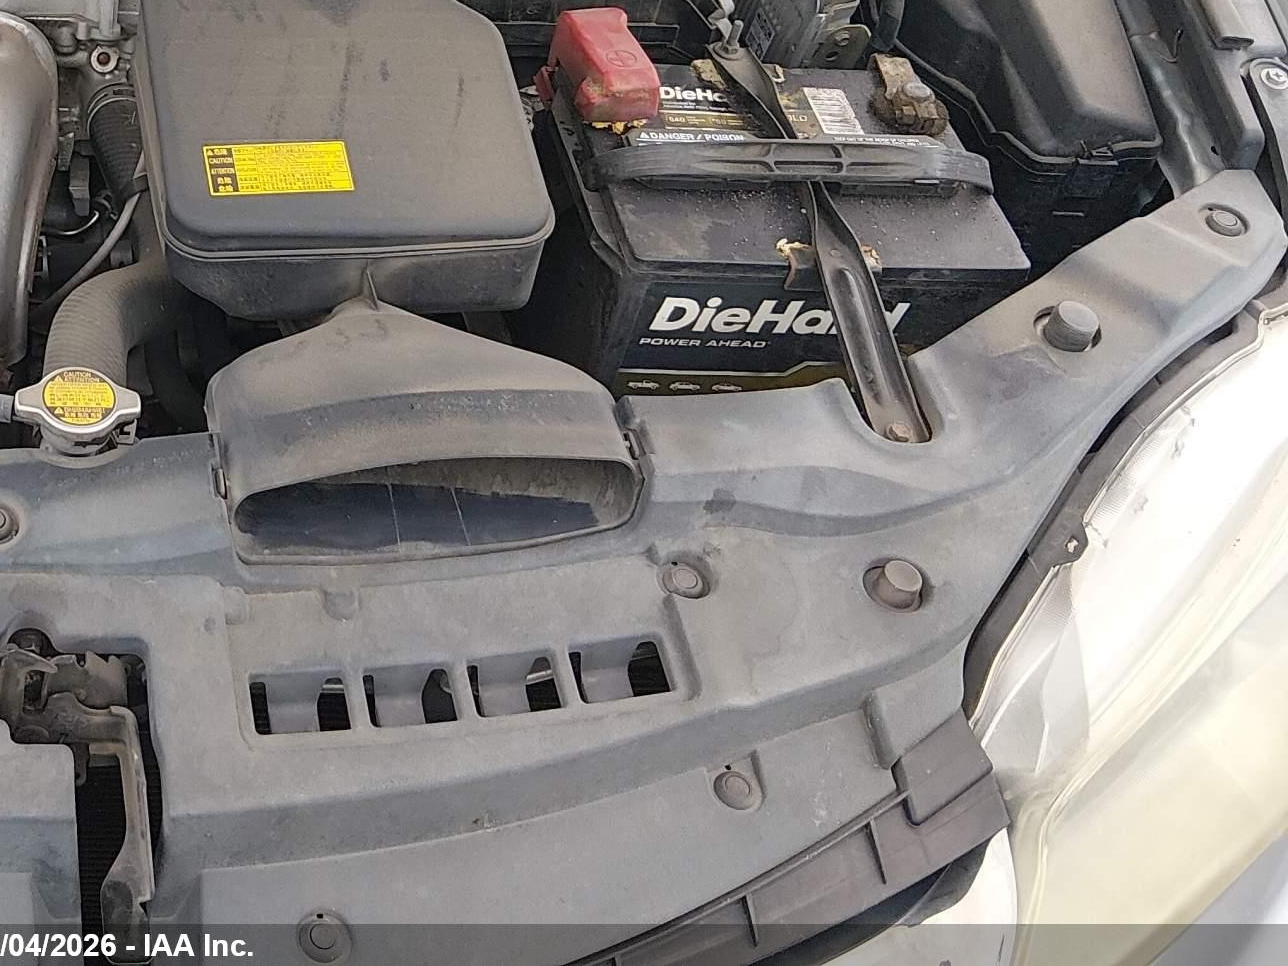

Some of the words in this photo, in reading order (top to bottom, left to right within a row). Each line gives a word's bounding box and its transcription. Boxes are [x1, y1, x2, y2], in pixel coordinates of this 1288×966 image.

[650, 133, 695, 141] DANGER
[705, 134, 745, 142] POISON
[638, 337, 701, 347] POWER
[704, 339, 767, 348] AHEAD
